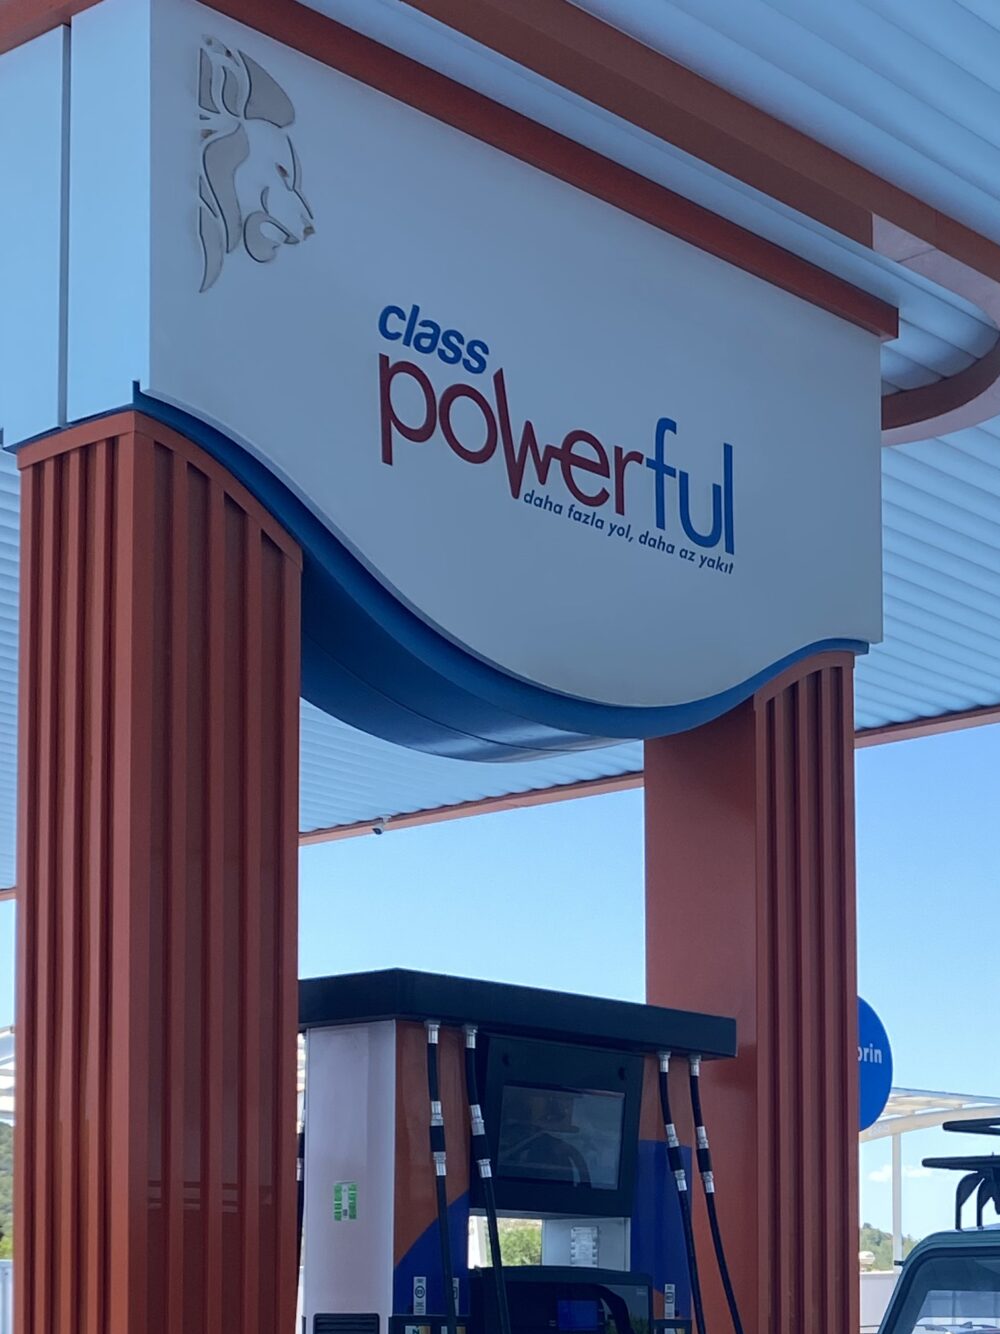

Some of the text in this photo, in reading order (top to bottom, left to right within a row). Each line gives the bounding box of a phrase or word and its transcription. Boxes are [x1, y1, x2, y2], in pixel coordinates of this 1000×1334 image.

[377, 303, 490, 374] class
[378, 352, 735, 555] powerful
[523, 489, 734, 575] daha fazla yol, daha az yakıt
